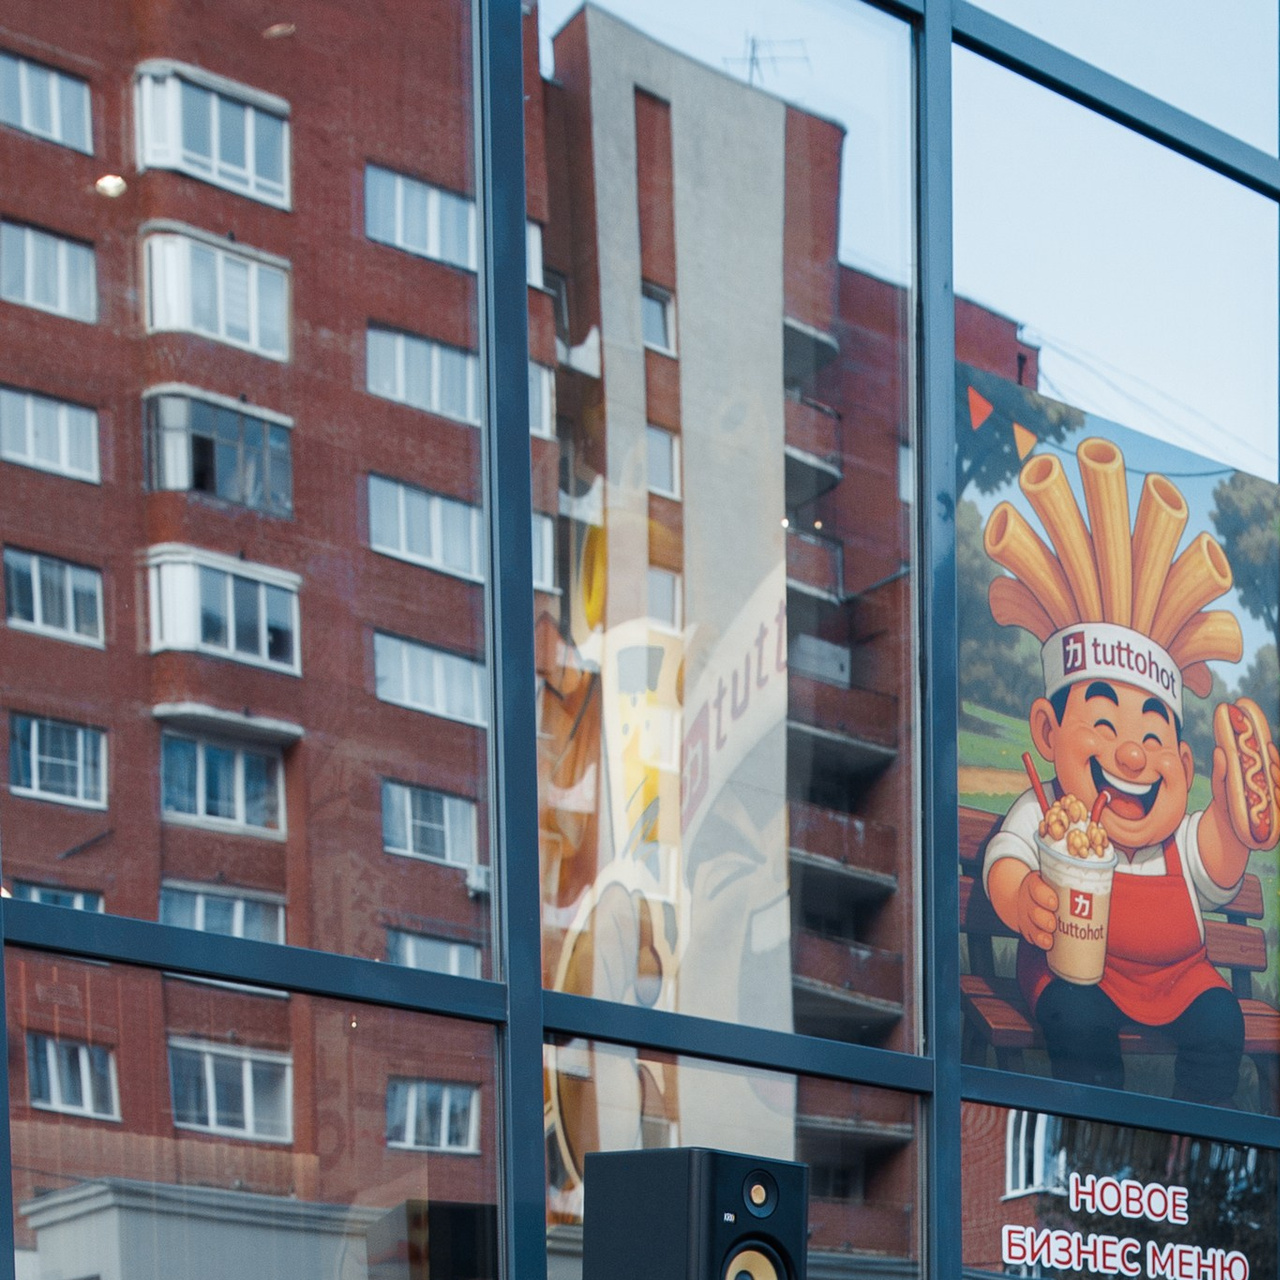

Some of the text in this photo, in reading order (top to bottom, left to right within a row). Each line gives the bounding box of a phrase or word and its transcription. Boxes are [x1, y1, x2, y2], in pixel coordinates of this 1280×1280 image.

[1092, 637, 1176, 699] tuttohot
[1058, 916, 1104, 940] tuttohot
[1070, 1173, 1188, 1223] НОВОЕ
[1003, 1226, 1140, 1276] БИЗНЕС
